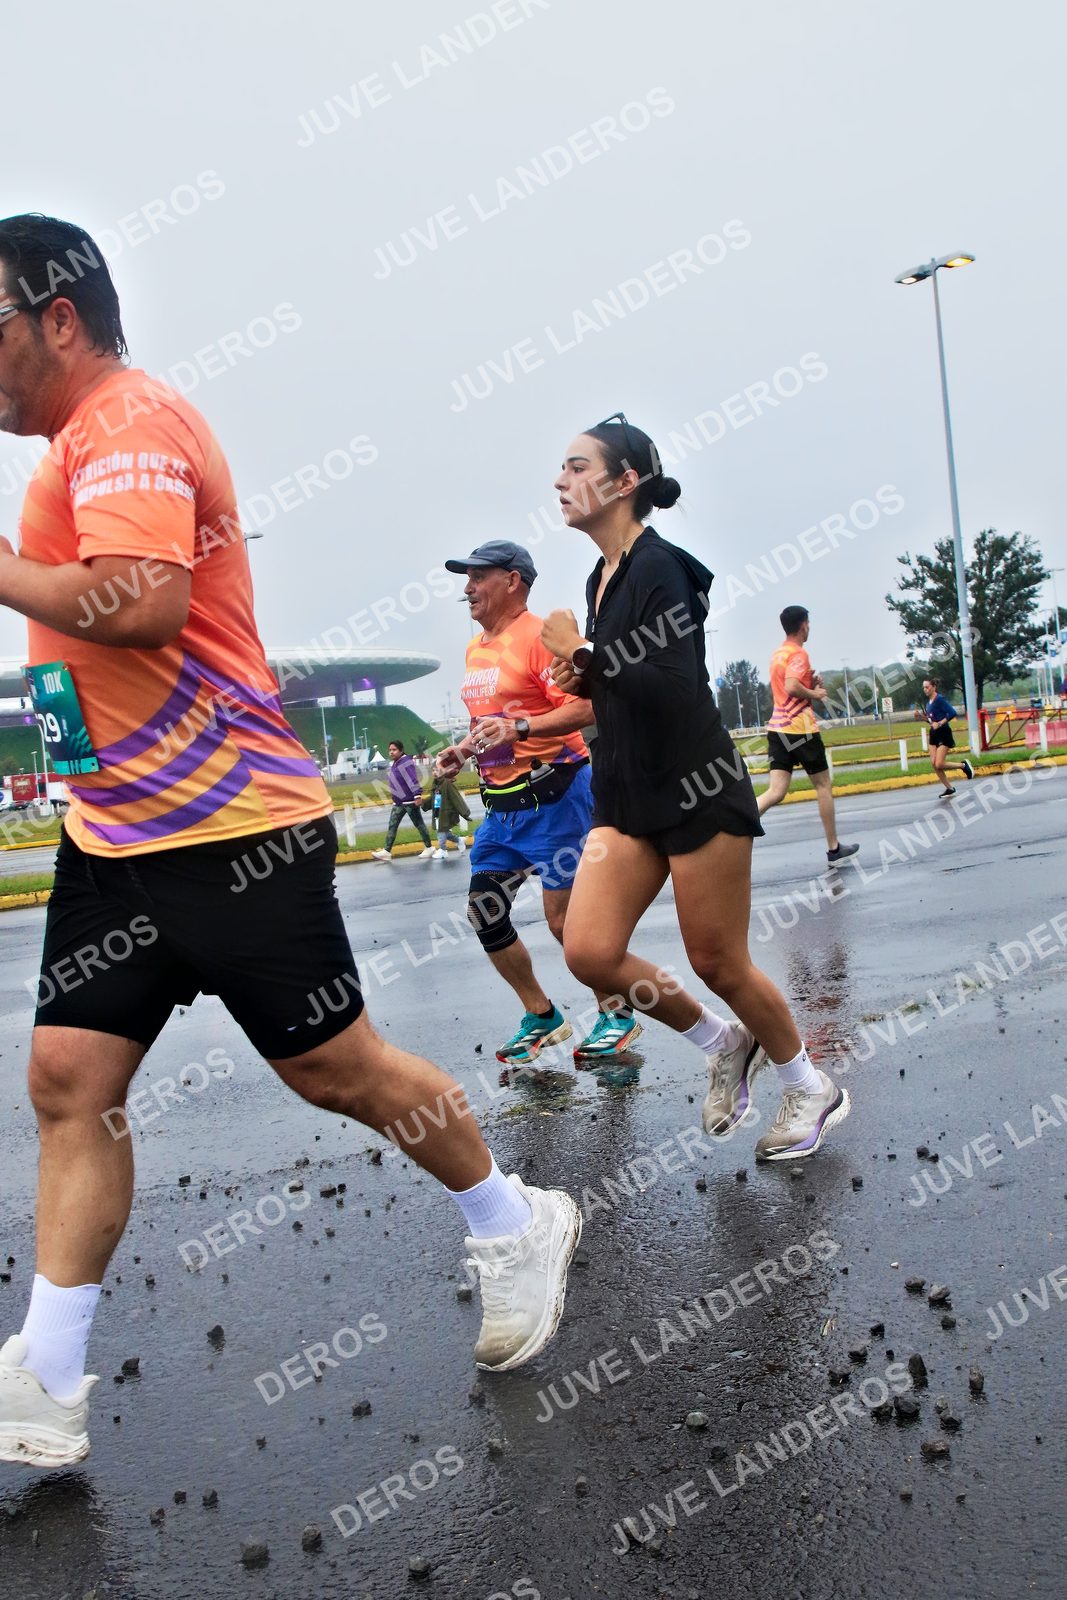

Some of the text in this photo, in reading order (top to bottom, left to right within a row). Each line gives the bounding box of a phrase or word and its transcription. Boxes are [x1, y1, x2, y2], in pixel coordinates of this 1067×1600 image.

[138, 451, 168, 472] QUE
[141, 472, 155, 491] A
[42, 671, 64, 695] 10K
